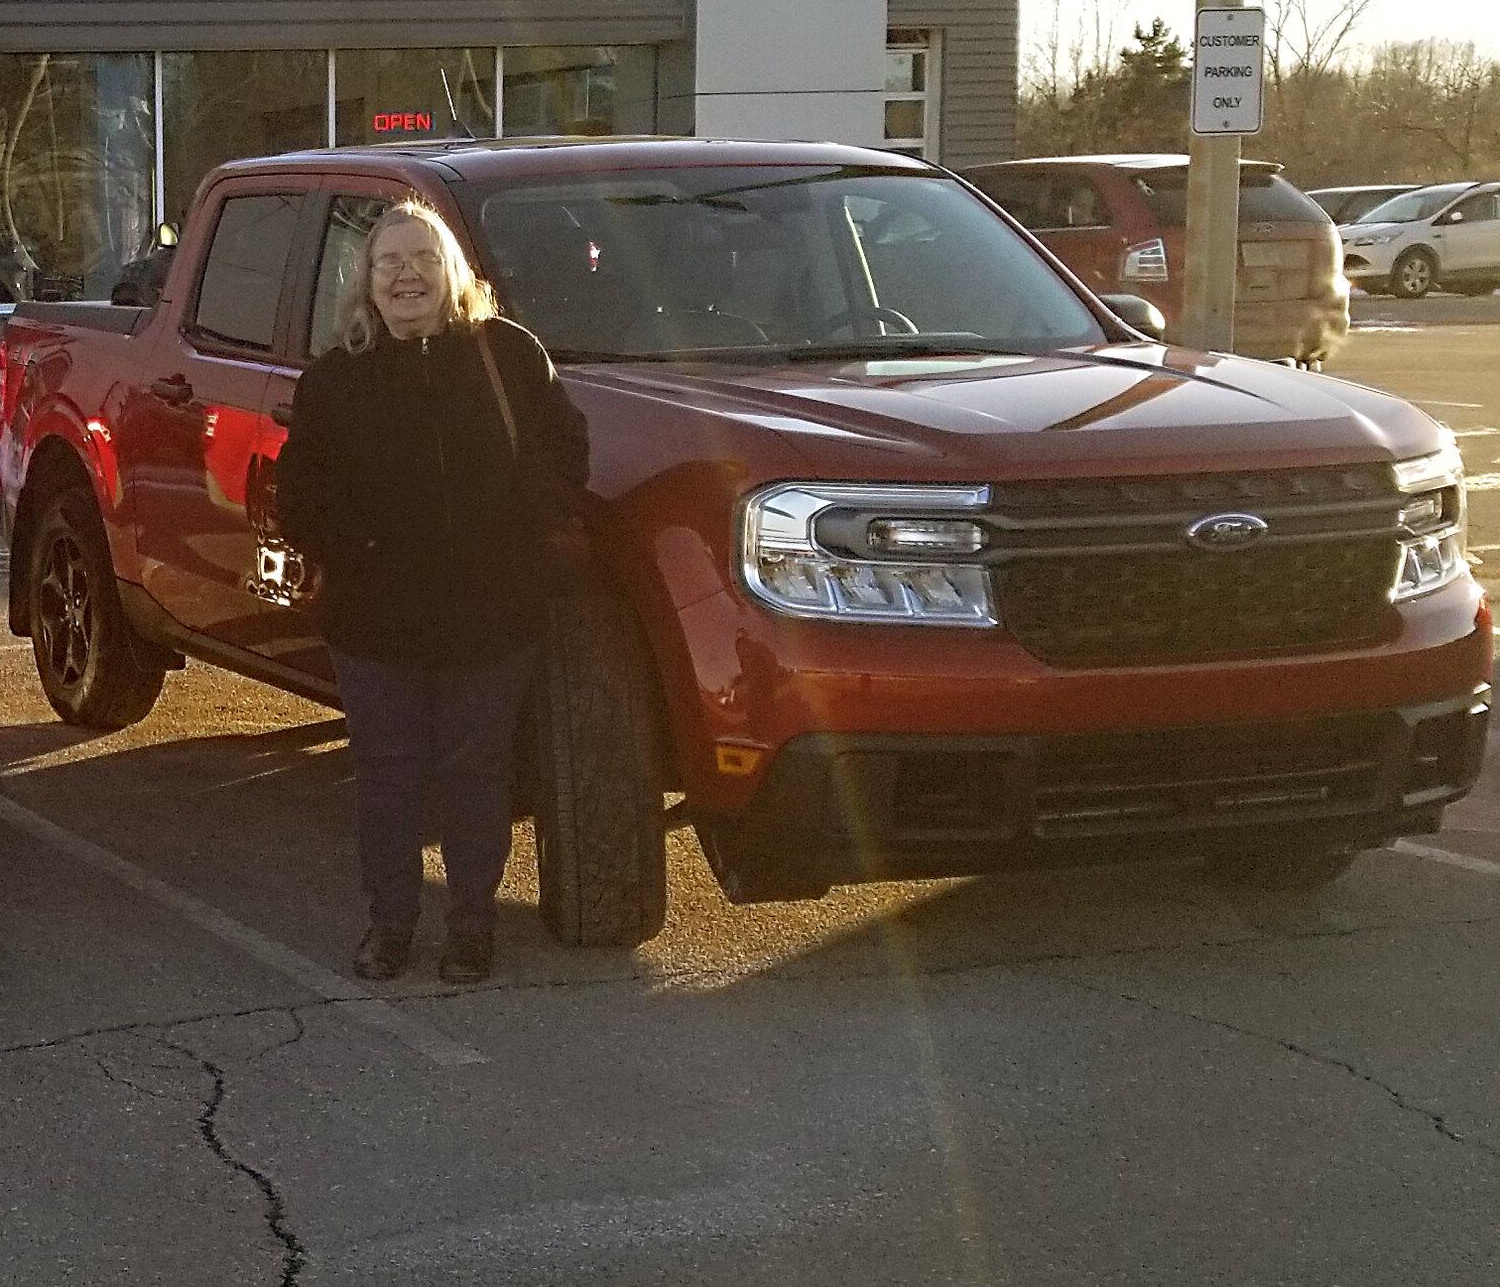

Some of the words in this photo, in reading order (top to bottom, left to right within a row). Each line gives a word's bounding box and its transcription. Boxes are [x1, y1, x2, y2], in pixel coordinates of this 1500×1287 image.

[1200, 35, 1260, 47] CUSTOMER
[1204, 66, 1253, 78] PARKING
[1213, 97, 1242, 109] ONLY
[374, 113, 432, 131] OPEN
